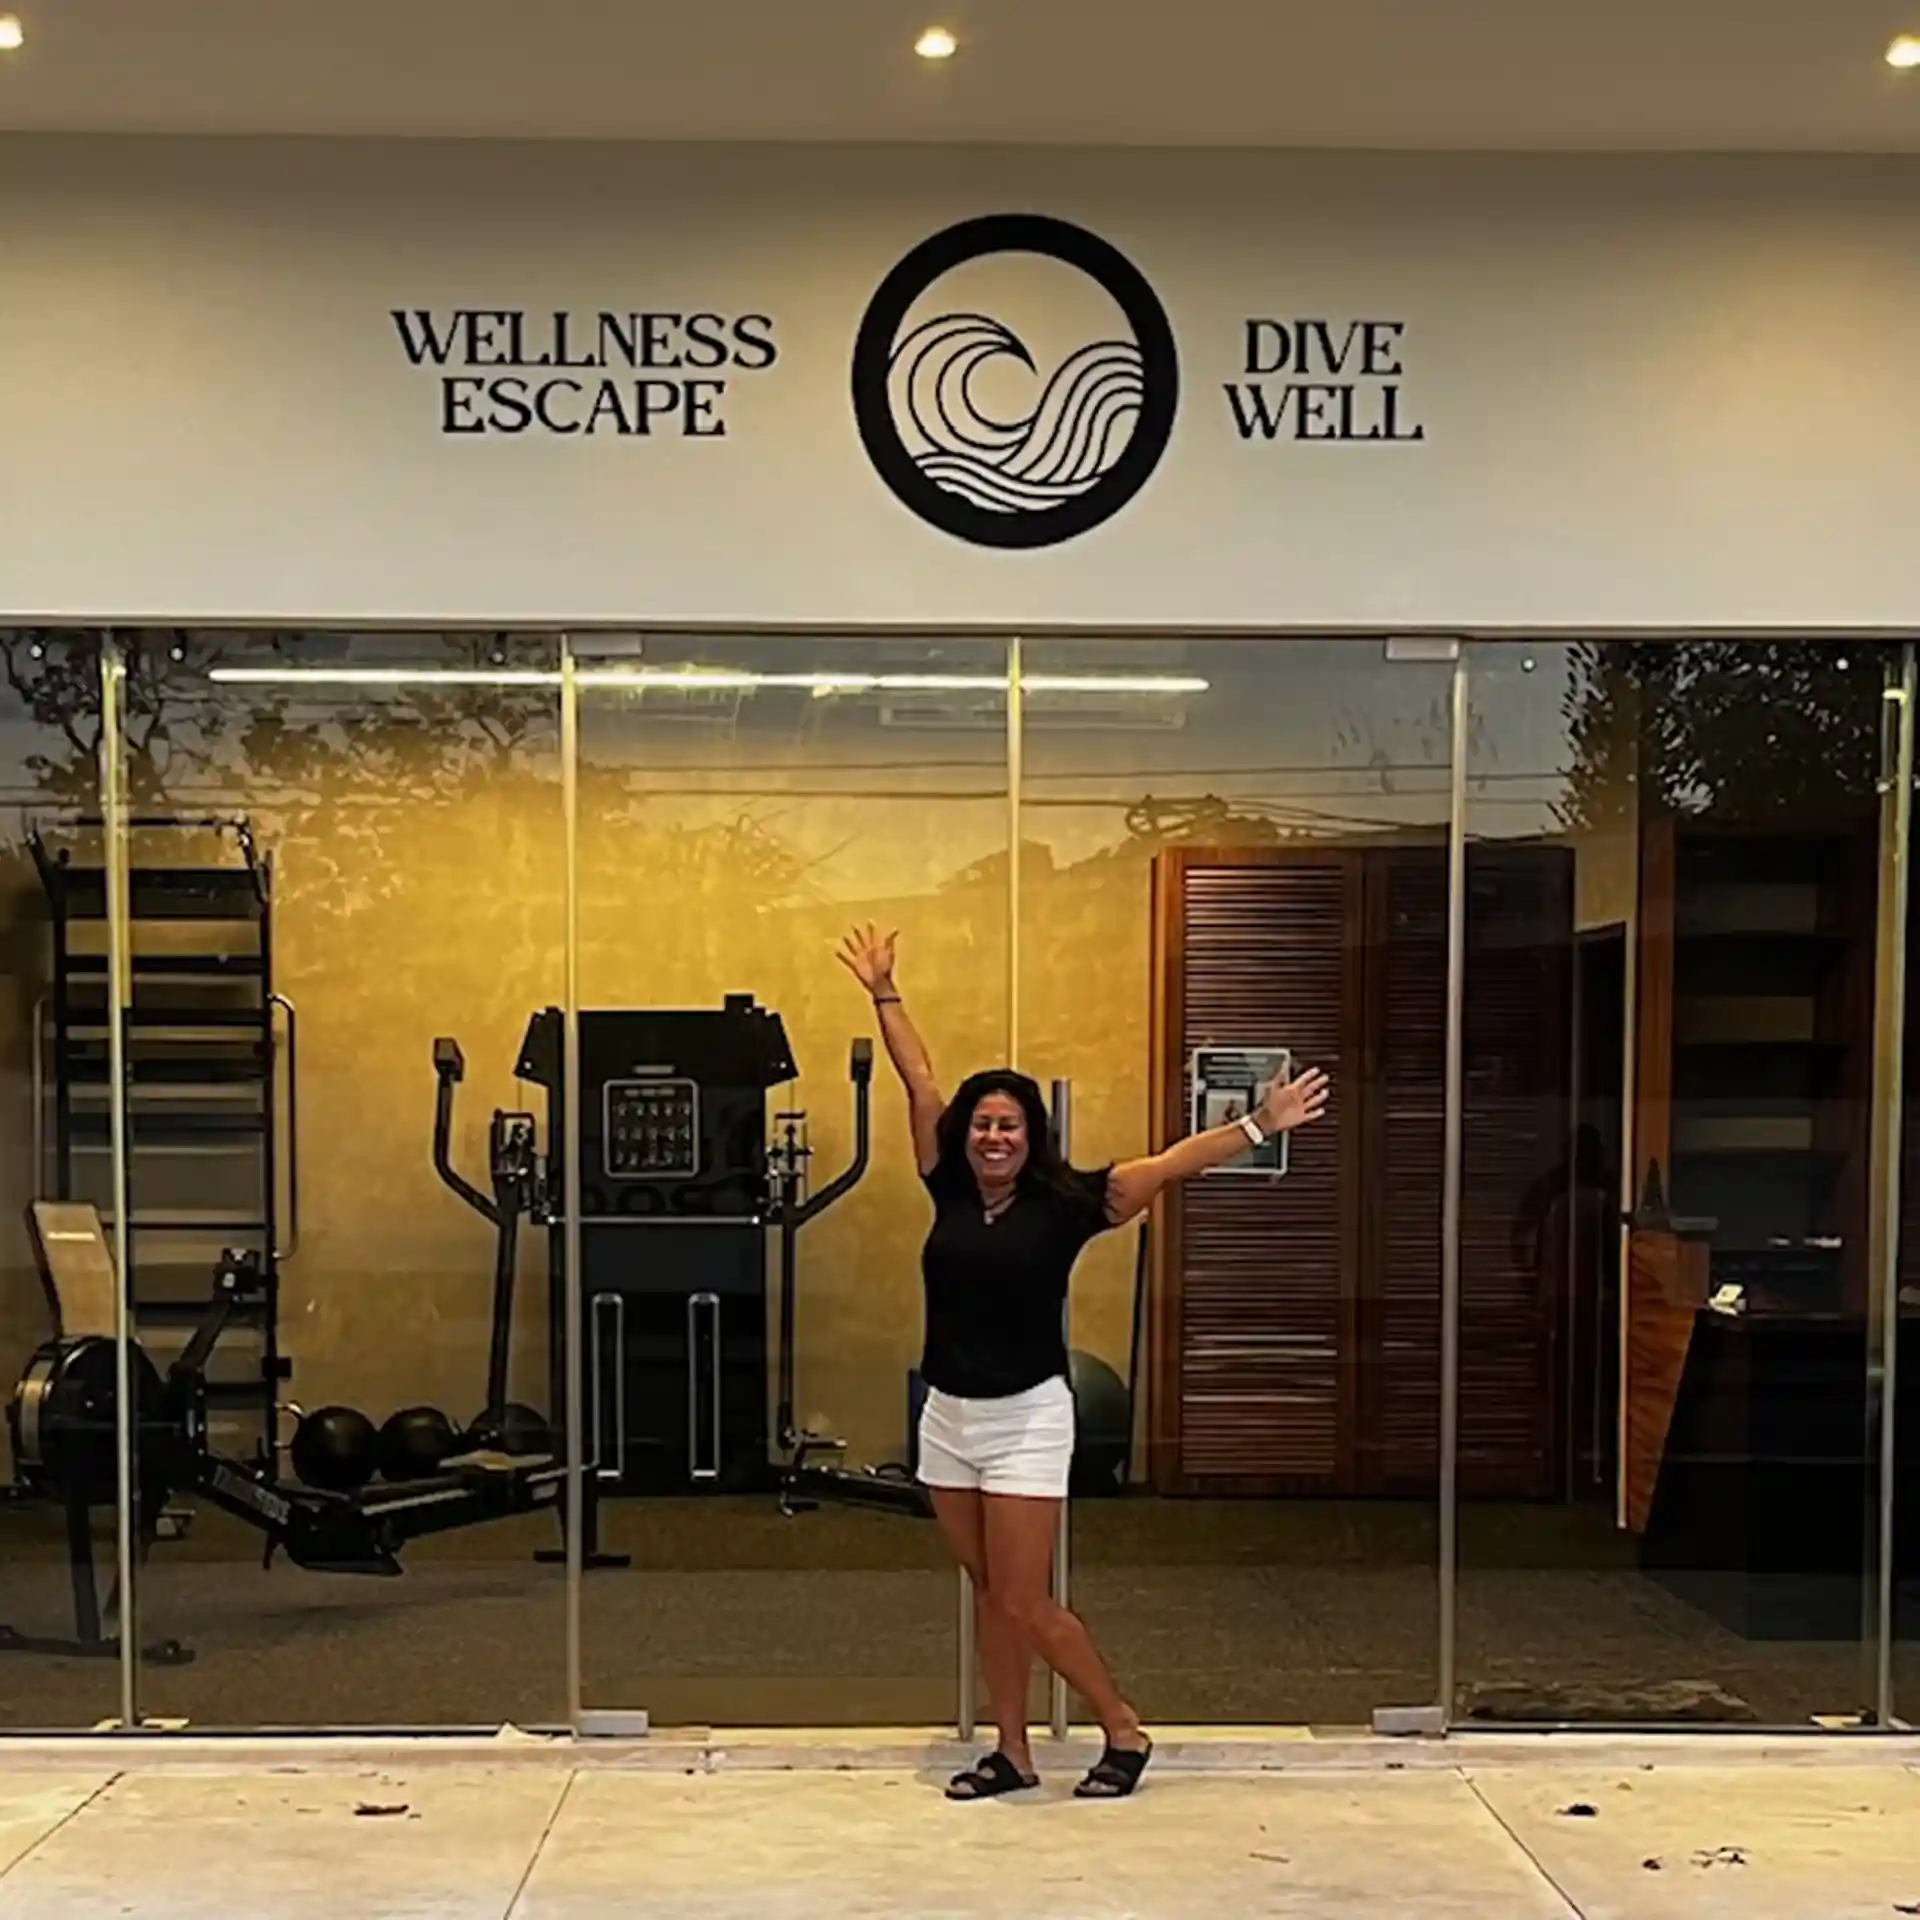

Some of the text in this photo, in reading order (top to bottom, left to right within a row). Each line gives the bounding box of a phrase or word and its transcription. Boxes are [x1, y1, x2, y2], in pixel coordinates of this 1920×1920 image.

[391, 310, 776, 369] WELLNESS
[1244, 319, 1404, 376] DIVE
[441, 377, 726, 436] ESCAPE
[1223, 383, 1424, 440] WELL
